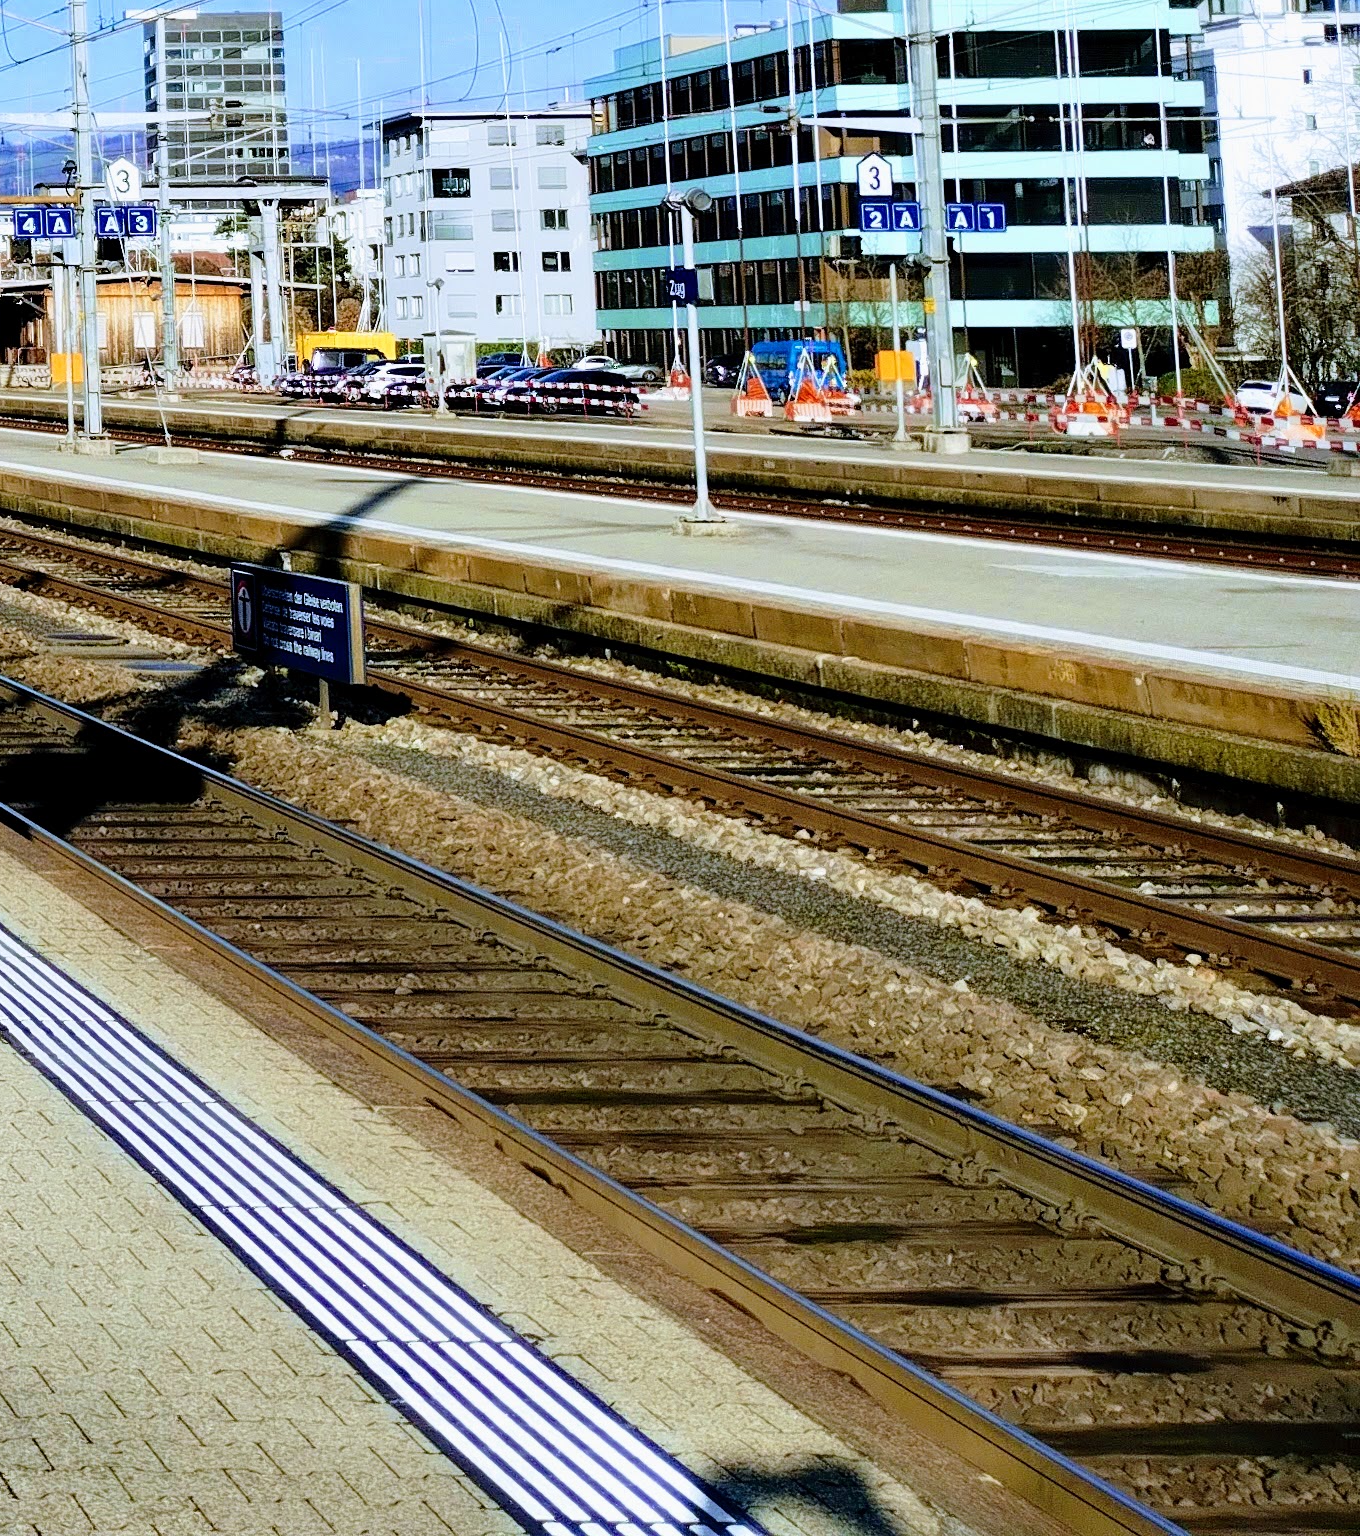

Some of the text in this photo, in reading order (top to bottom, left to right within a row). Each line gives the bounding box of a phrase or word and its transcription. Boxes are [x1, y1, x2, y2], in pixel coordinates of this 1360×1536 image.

[116, 169, 130, 194] 3
[868, 166, 881, 191] 3
[22, 217, 36, 234] 4
[52, 216, 67, 233] A
[104, 215, 121, 232] A
[135, 215, 148, 232] 3
[869, 210, 883, 229] 2
[899, 210, 914, 228] A
[954, 210, 968, 229] A
[986, 210, 995, 229] 1
[669, 279, 686, 300] Zug
